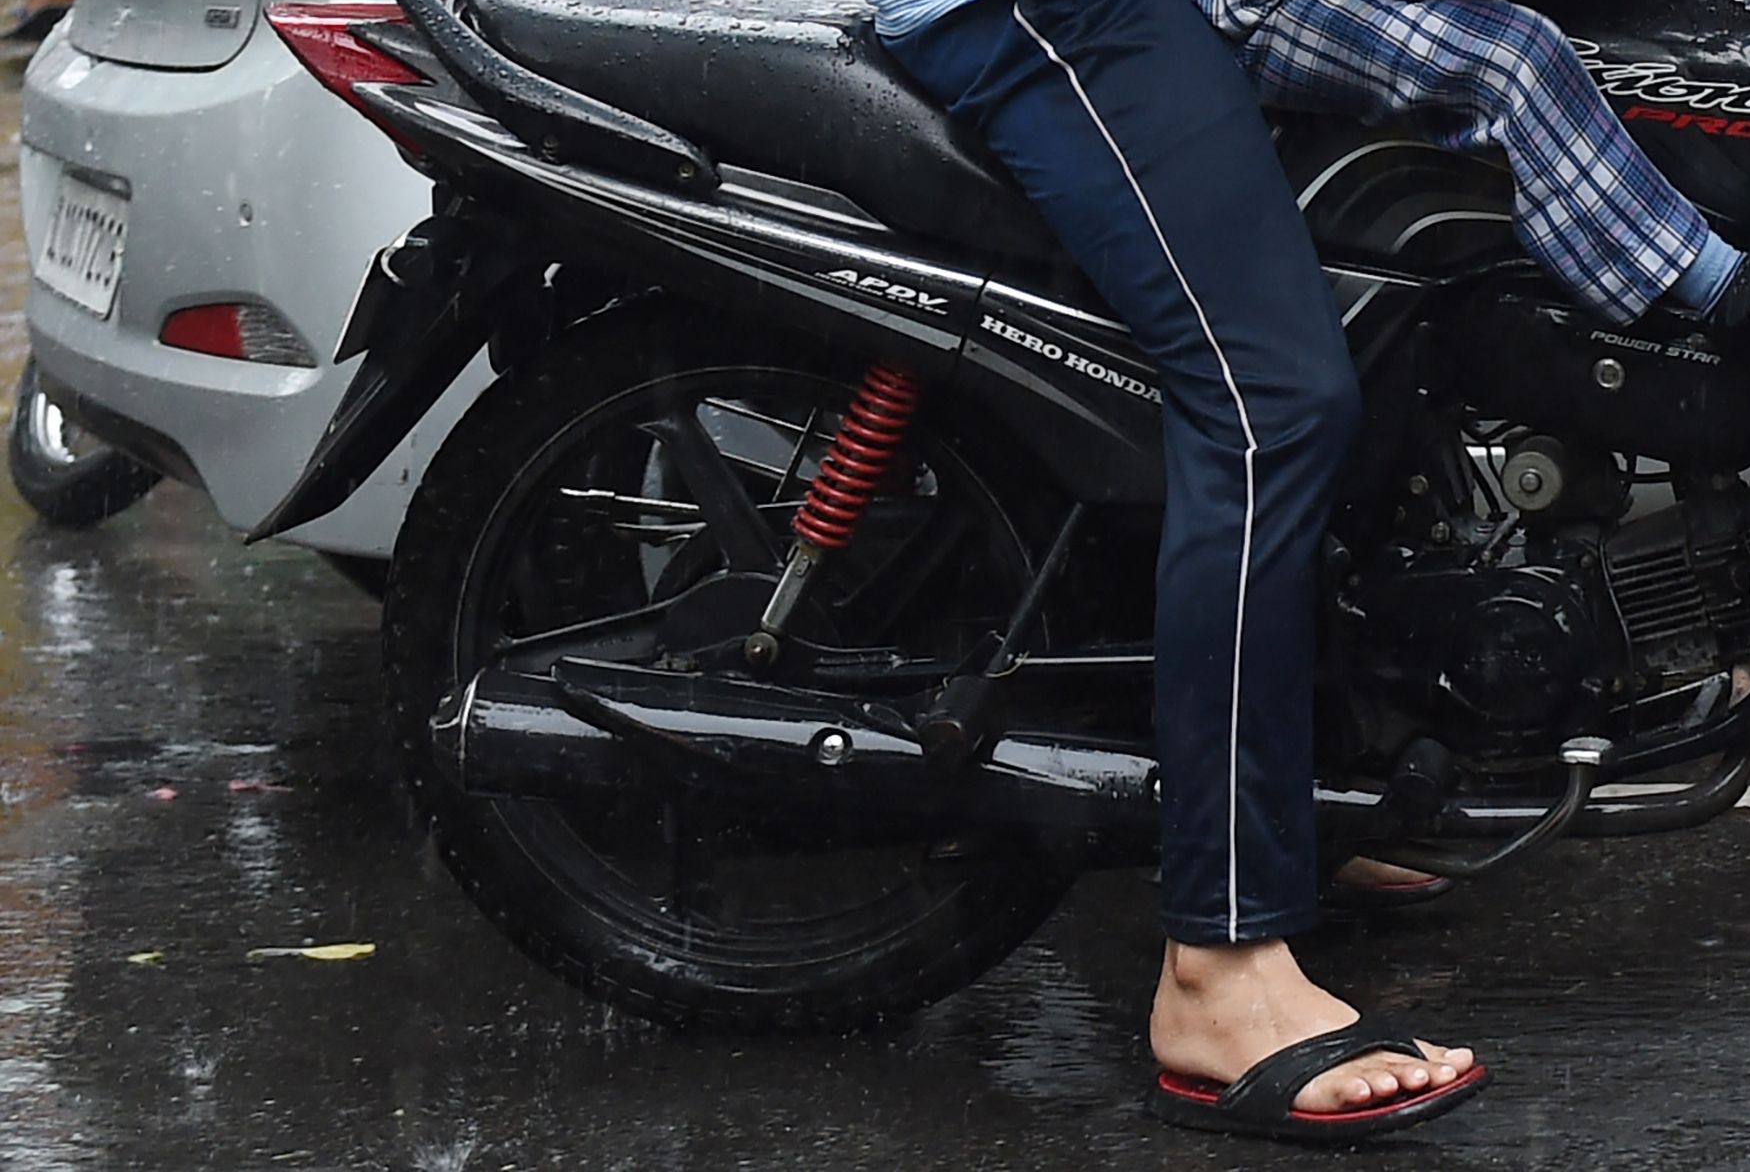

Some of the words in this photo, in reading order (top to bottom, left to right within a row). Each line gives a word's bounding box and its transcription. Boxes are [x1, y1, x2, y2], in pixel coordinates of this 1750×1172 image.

[827, 269, 949, 306] APDV
[980, 314, 1063, 360] HERO
[1063, 352, 1164, 405] HONDA
[1589, 330, 1662, 353] POWER
[1665, 345, 1722, 366] STAR
